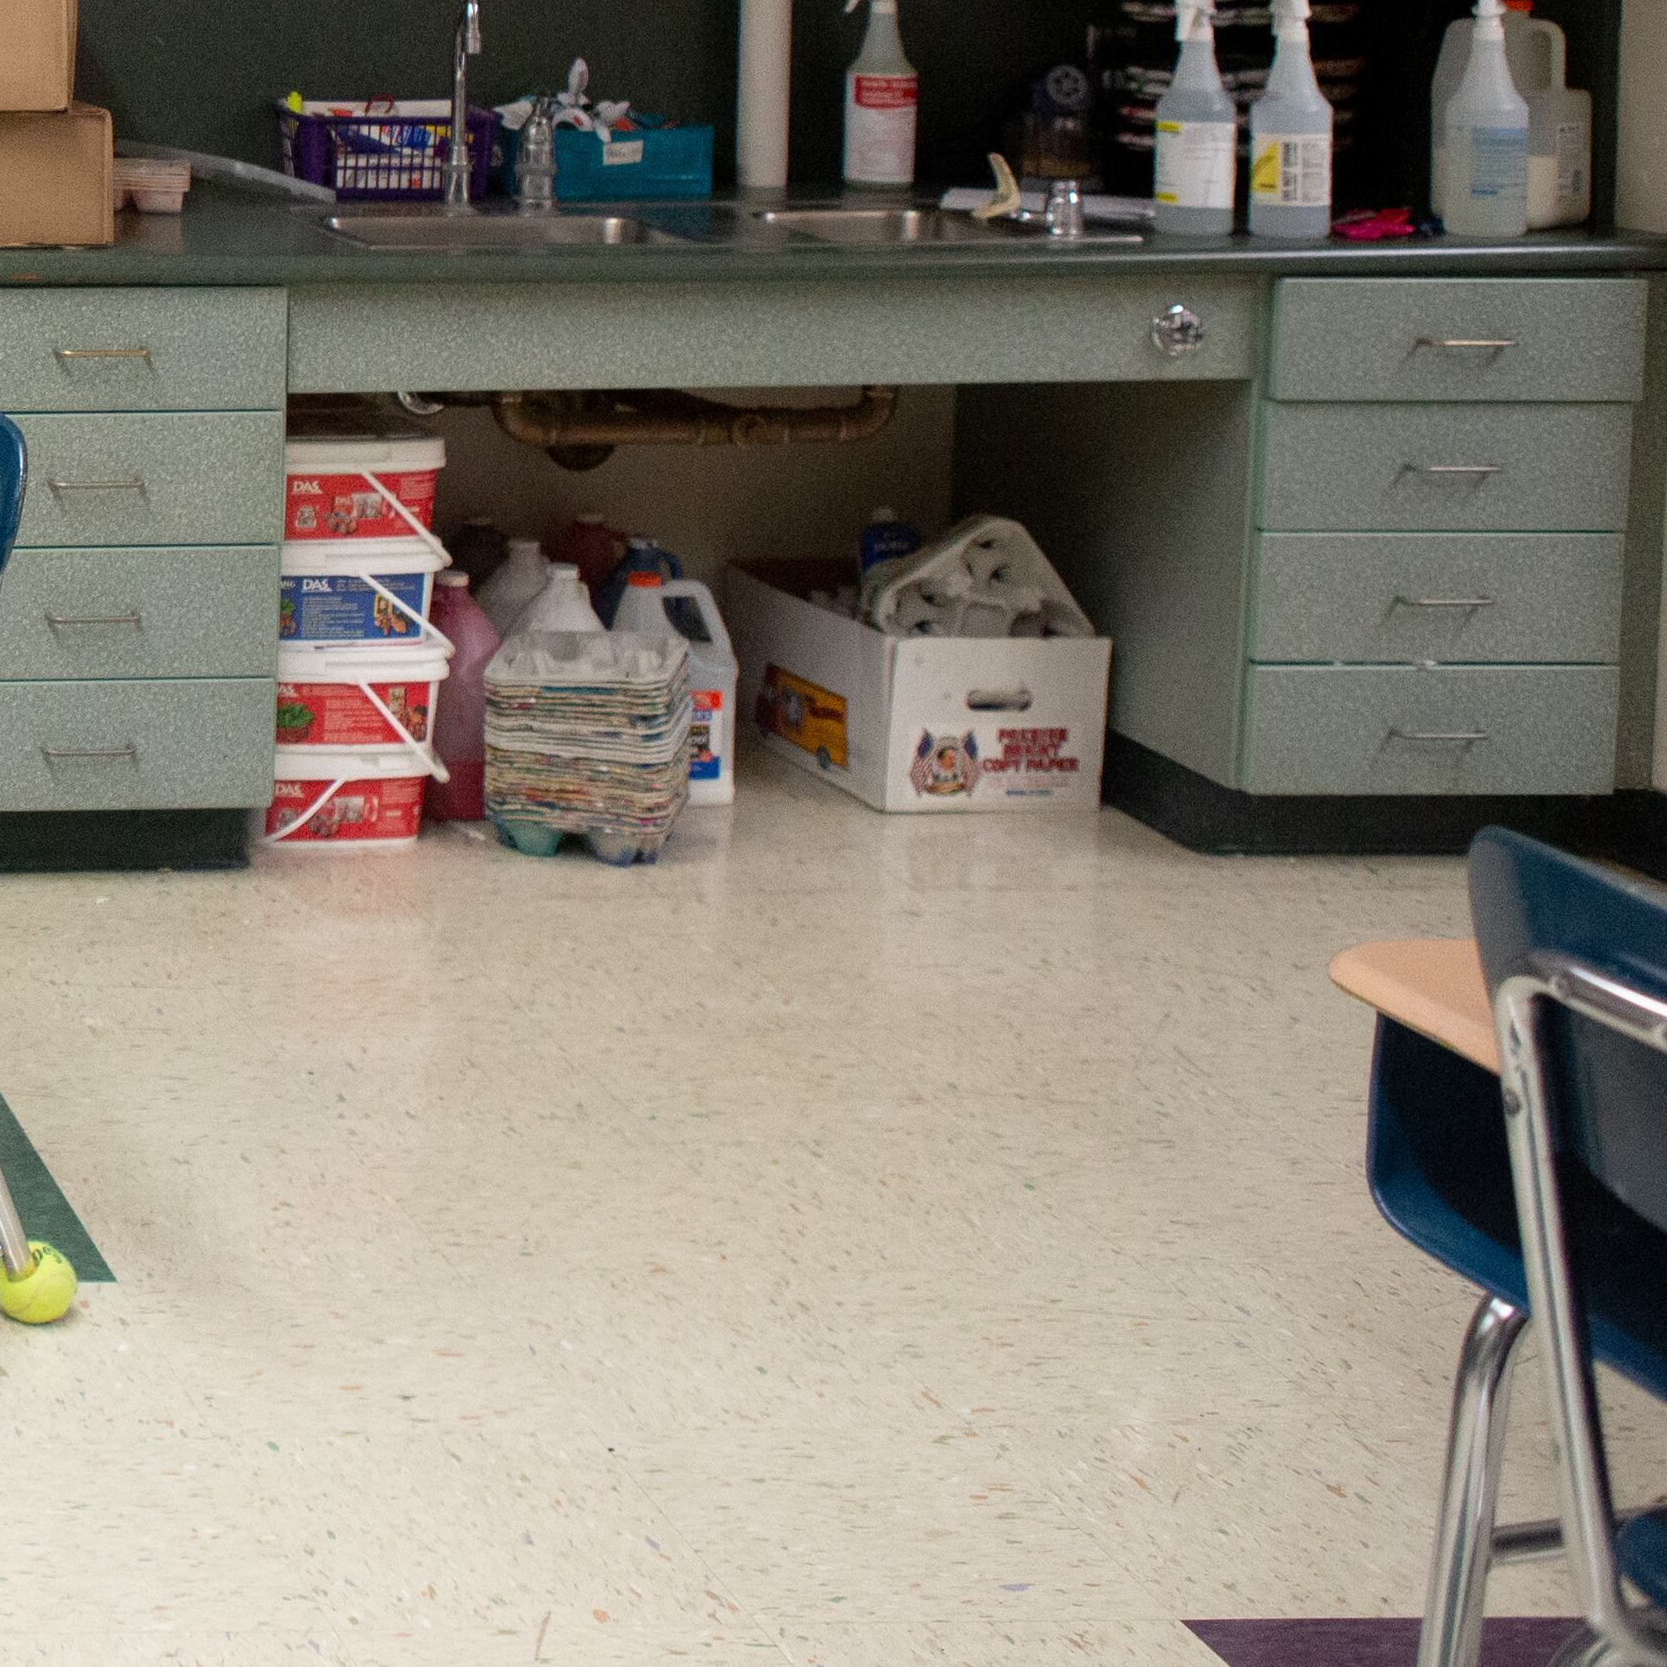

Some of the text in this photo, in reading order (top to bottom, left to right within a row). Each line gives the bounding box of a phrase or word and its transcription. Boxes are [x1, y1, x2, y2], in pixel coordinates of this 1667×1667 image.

[292, 481, 322, 494] DAS
[302, 579, 332, 592] DAS
[277, 684, 299, 698] AS
